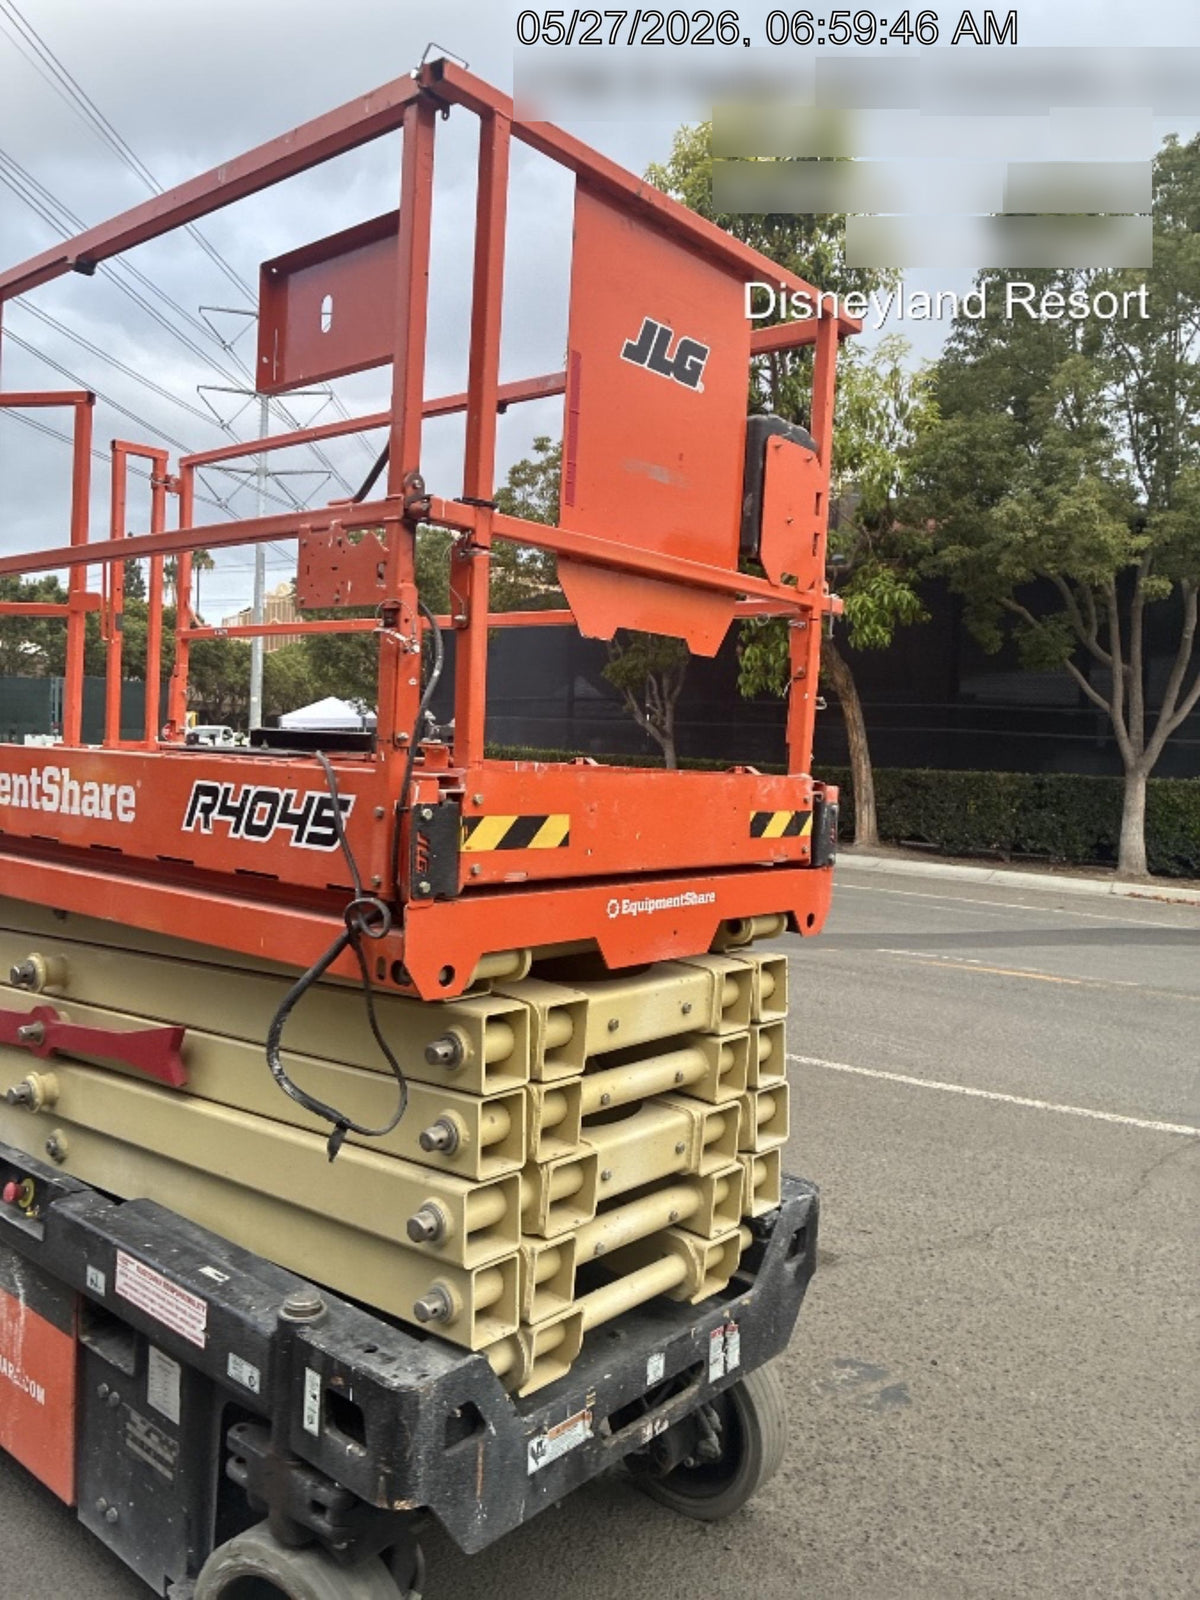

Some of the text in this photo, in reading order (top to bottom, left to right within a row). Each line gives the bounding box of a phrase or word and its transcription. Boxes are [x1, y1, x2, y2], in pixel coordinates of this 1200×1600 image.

[620, 317, 710, 392] JLG
[181, 779, 357, 853] R4045
[621, 891, 716, 917] EquipmentShare
